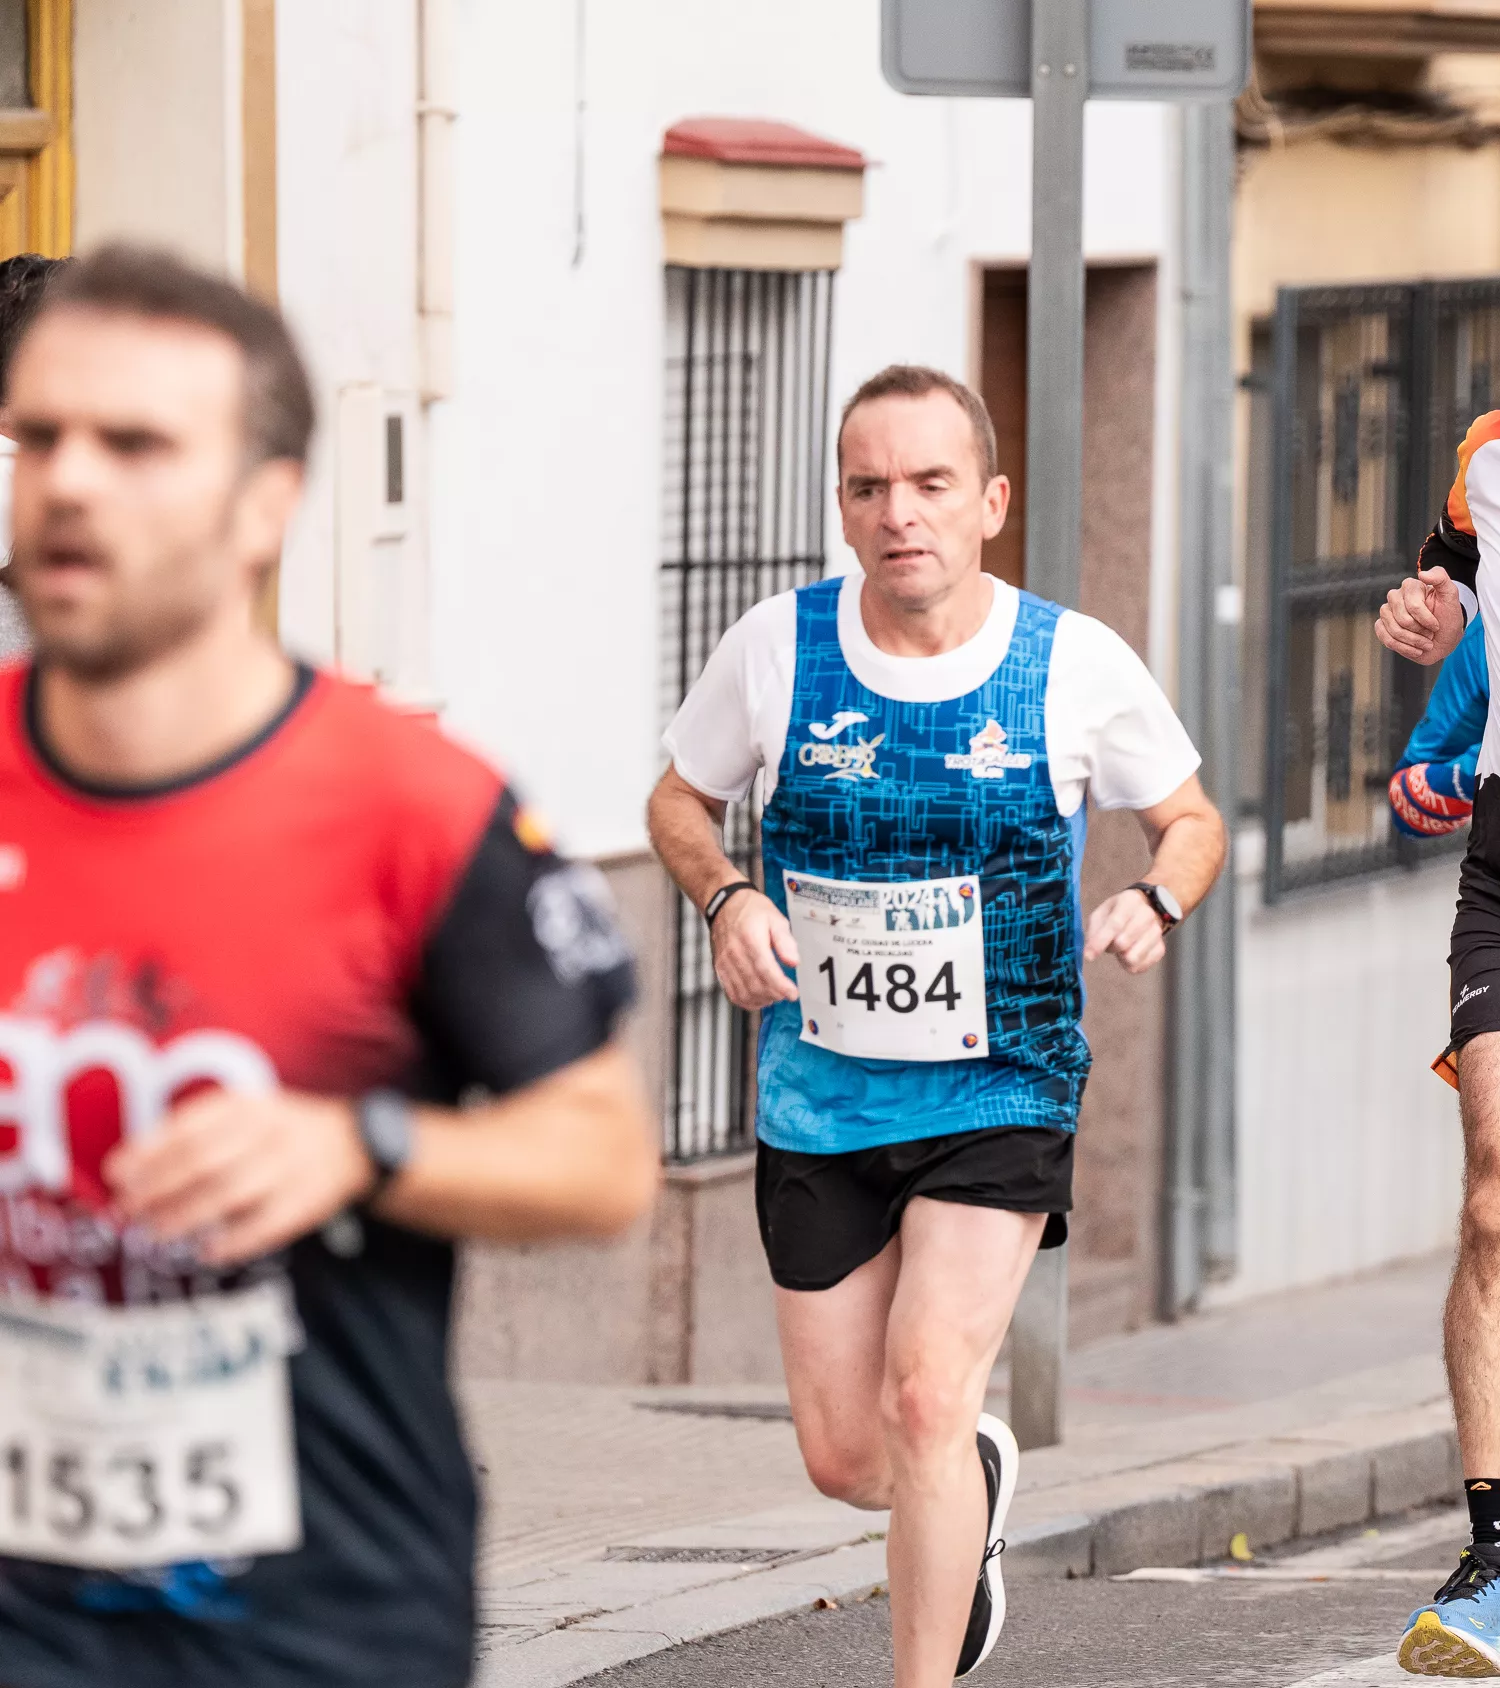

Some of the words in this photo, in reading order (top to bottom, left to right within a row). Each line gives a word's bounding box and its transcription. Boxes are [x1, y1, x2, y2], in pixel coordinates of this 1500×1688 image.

[884, 888, 936, 910] 2024
[819, 956, 962, 1013] 1484
[4, 1440, 242, 1541] 1535
